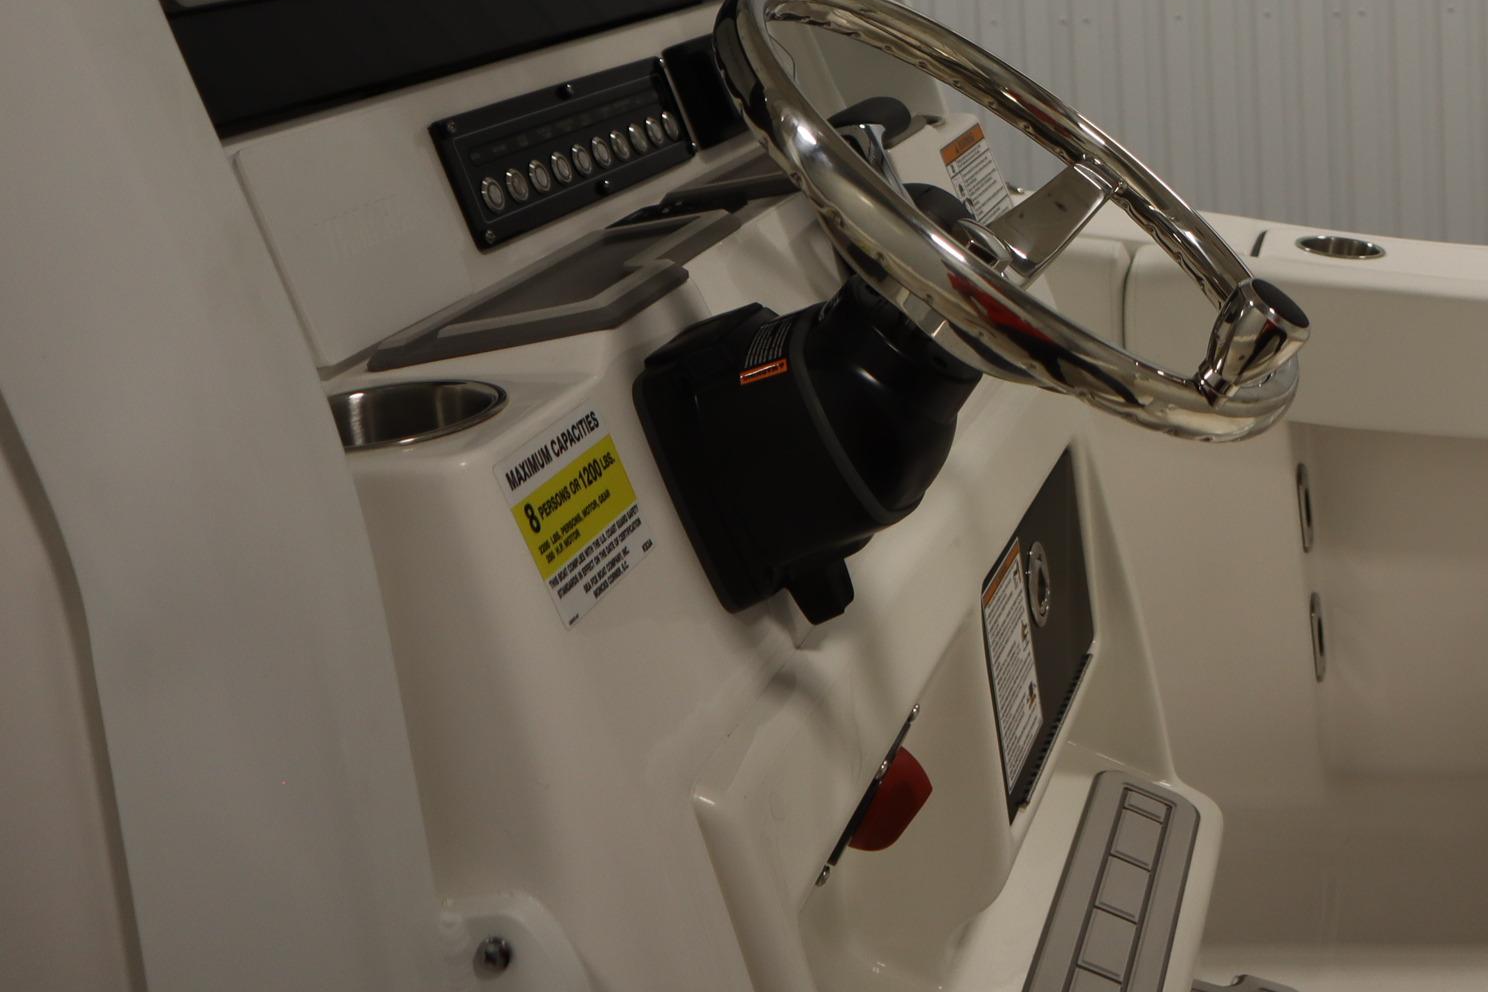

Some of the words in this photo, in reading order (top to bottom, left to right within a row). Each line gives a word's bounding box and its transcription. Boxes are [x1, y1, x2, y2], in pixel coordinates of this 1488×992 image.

[505, 445, 552, 491] MAXIMUM
[550, 411, 599, 457] CAPACITIES
[524, 503, 541, 533] 8
[538, 486, 571, 520] PERSONS
[569, 478, 581, 494] OR
[578, 459, 602, 488] 1200
[599, 452, 615, 470] LBS.
